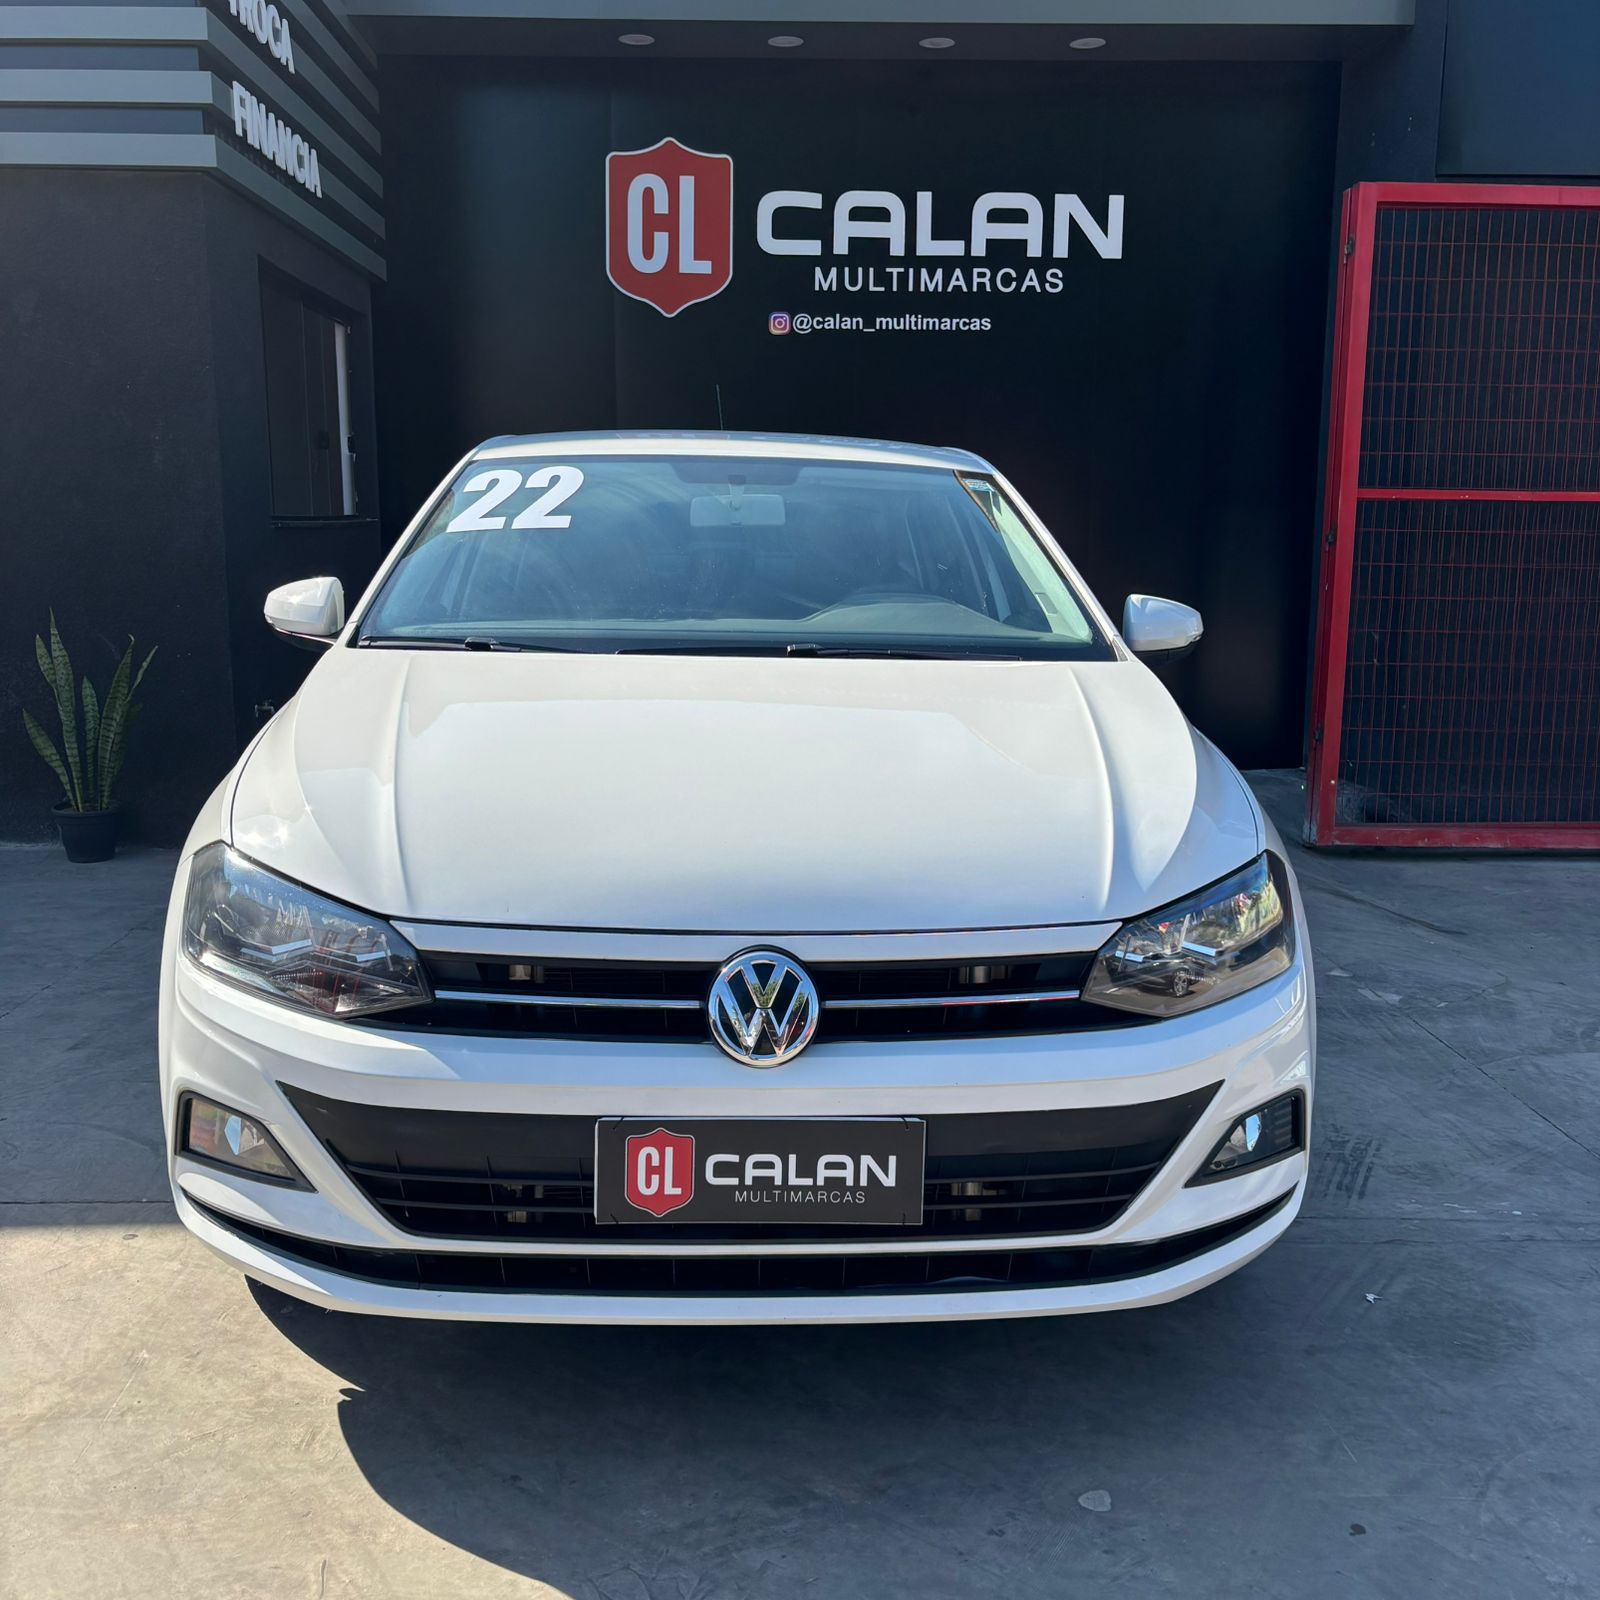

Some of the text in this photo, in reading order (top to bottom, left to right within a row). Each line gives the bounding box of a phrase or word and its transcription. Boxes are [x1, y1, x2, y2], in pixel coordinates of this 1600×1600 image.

[227, 0, 295, 75] ROCA
[232, 80, 323, 198] FINANCIA
[627, 173, 713, 275] CL
[756, 189, 1126, 260] CALAN
[813, 266, 1065, 293] MULTIMARCAS
[792, 313, 992, 334] @calan_multimarcas
[446, 466, 585, 533] 22
[636, 1146, 682, 1196] CL
[705, 1153, 897, 1187] CALAN
[735, 1190, 866, 1204] MULTIMARCAS
